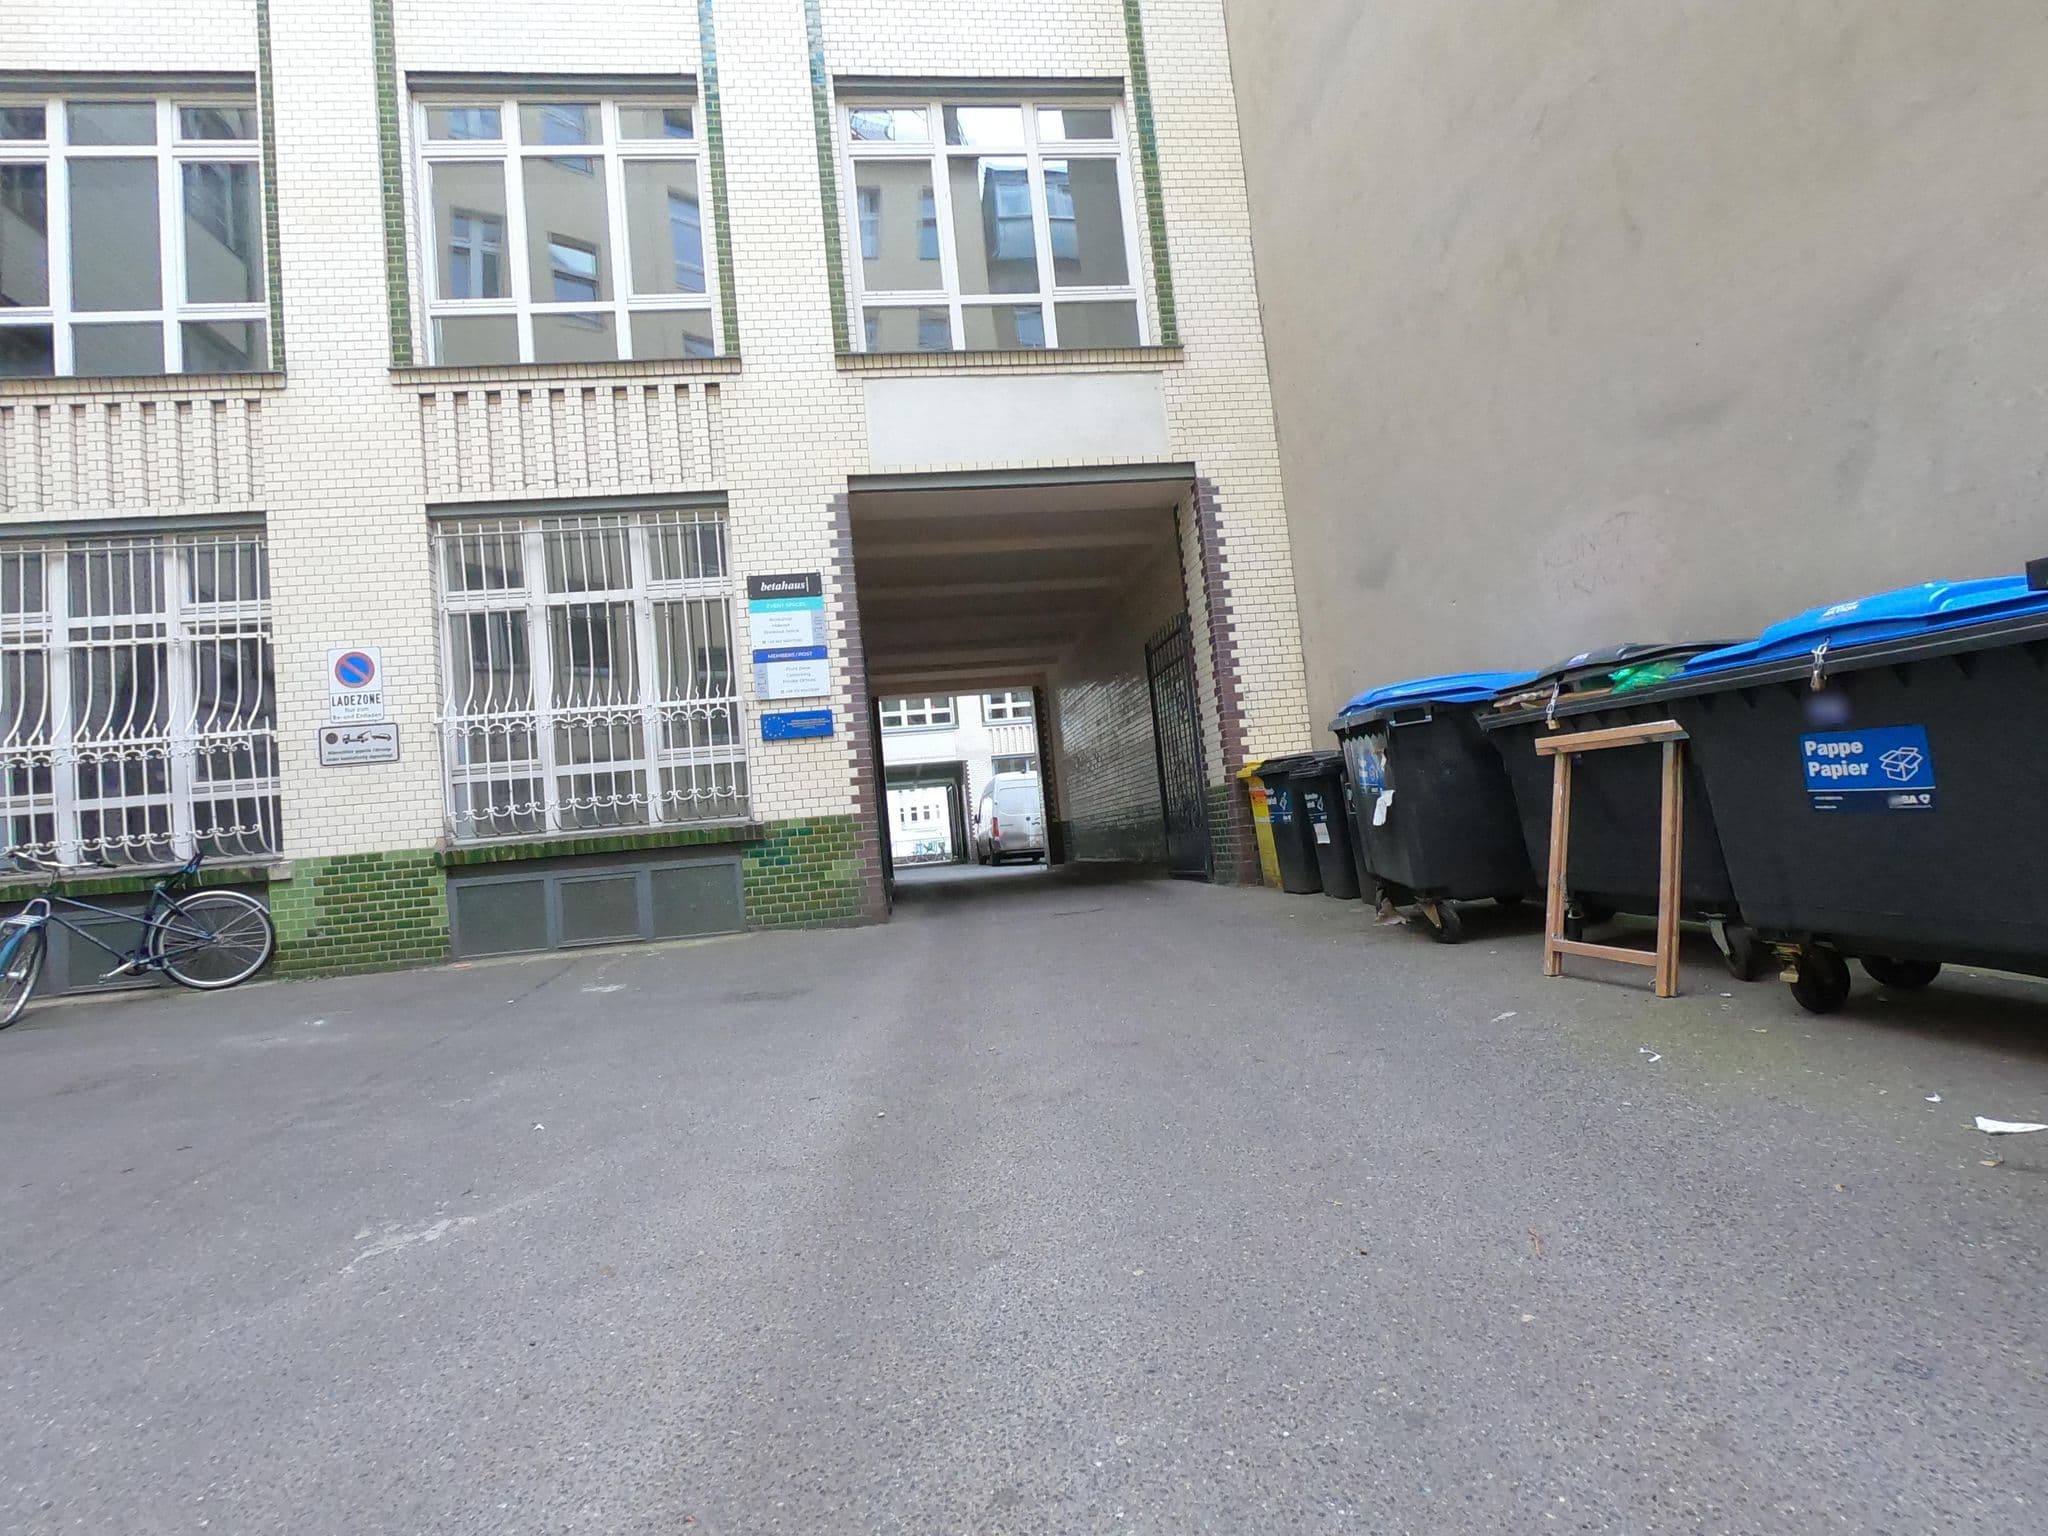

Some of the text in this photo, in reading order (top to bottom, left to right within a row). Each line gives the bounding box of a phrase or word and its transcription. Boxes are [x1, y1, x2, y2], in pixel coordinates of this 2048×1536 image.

[761, 580, 806, 592] betahaus
[331, 693, 382, 707] LADEZONE
[1804, 740, 1863, 758] Pappe
[1808, 760, 1869, 780] Papier
